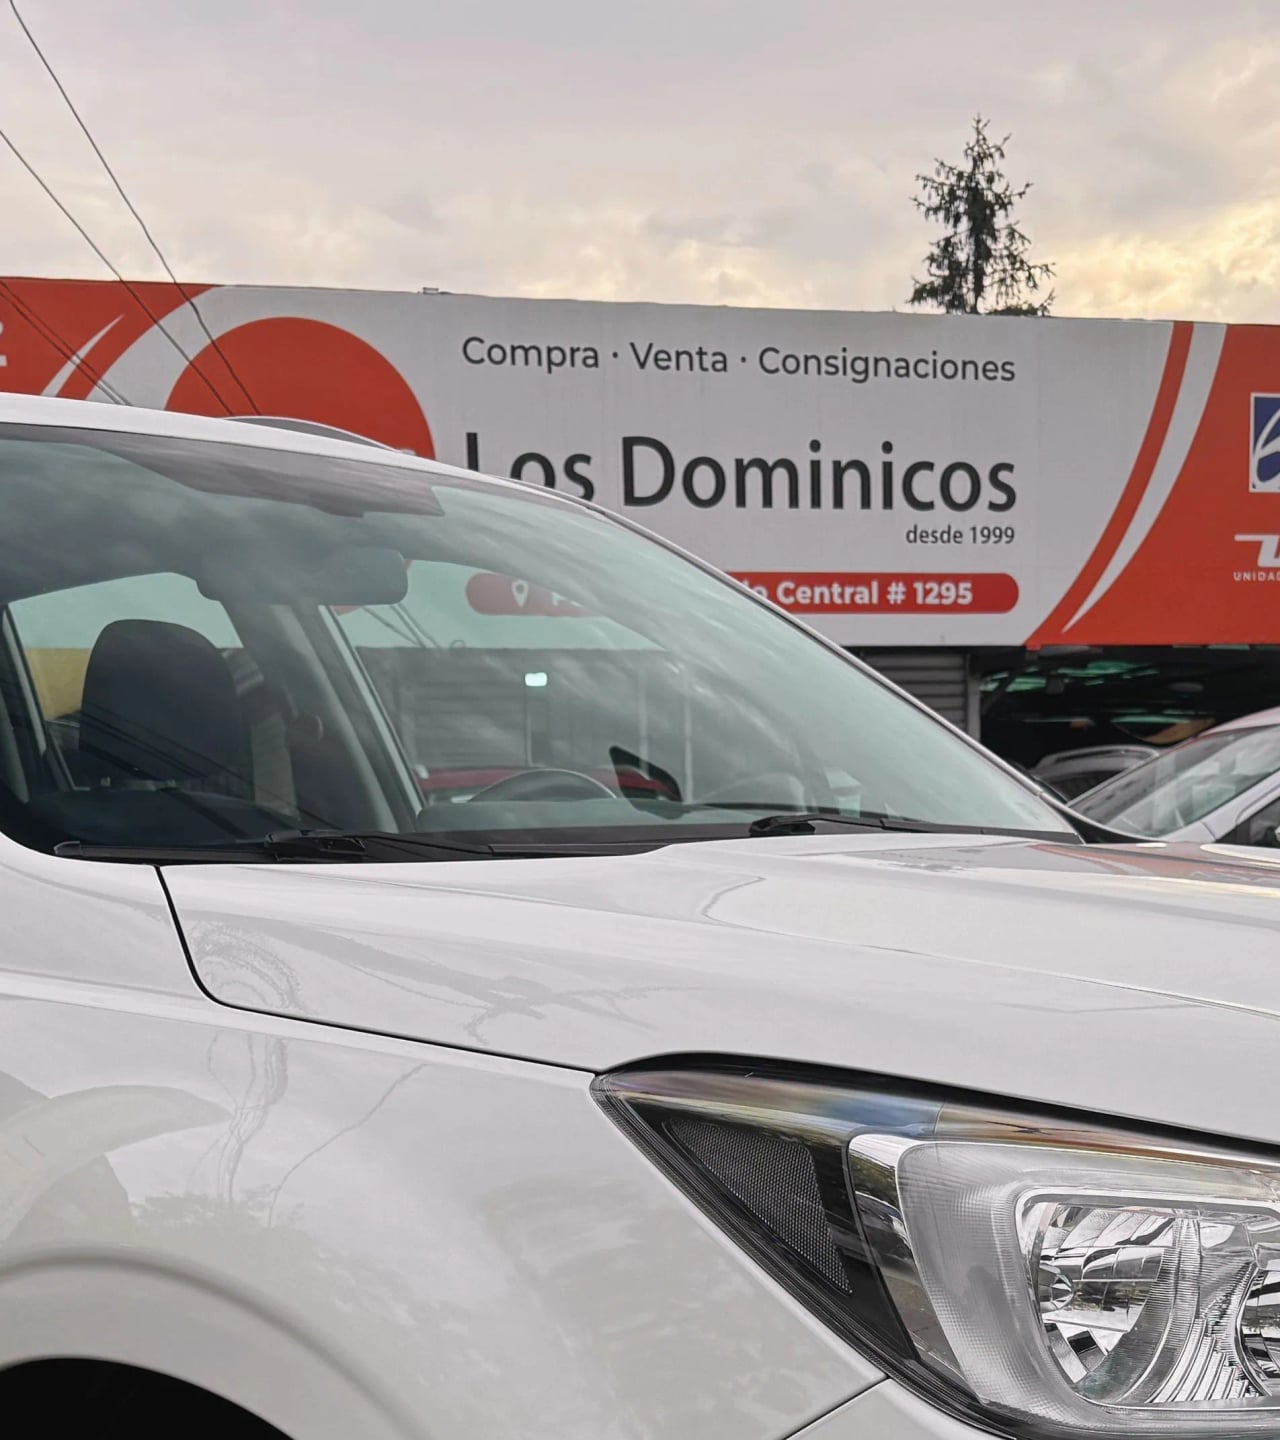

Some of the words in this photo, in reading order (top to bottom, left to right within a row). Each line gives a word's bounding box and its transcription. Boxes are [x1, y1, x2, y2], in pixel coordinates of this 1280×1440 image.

[461, 336, 600, 374] Compra
[629, 342, 727, 373] Venta
[758, 345, 1016, 383] Consignaciones
[621, 435, 1017, 513] Dominicos
[906, 523, 964, 545] desde
[969, 525, 1016, 545] 1999
[776, 580, 879, 605] Central
[912, 581, 973, 605] 1295
